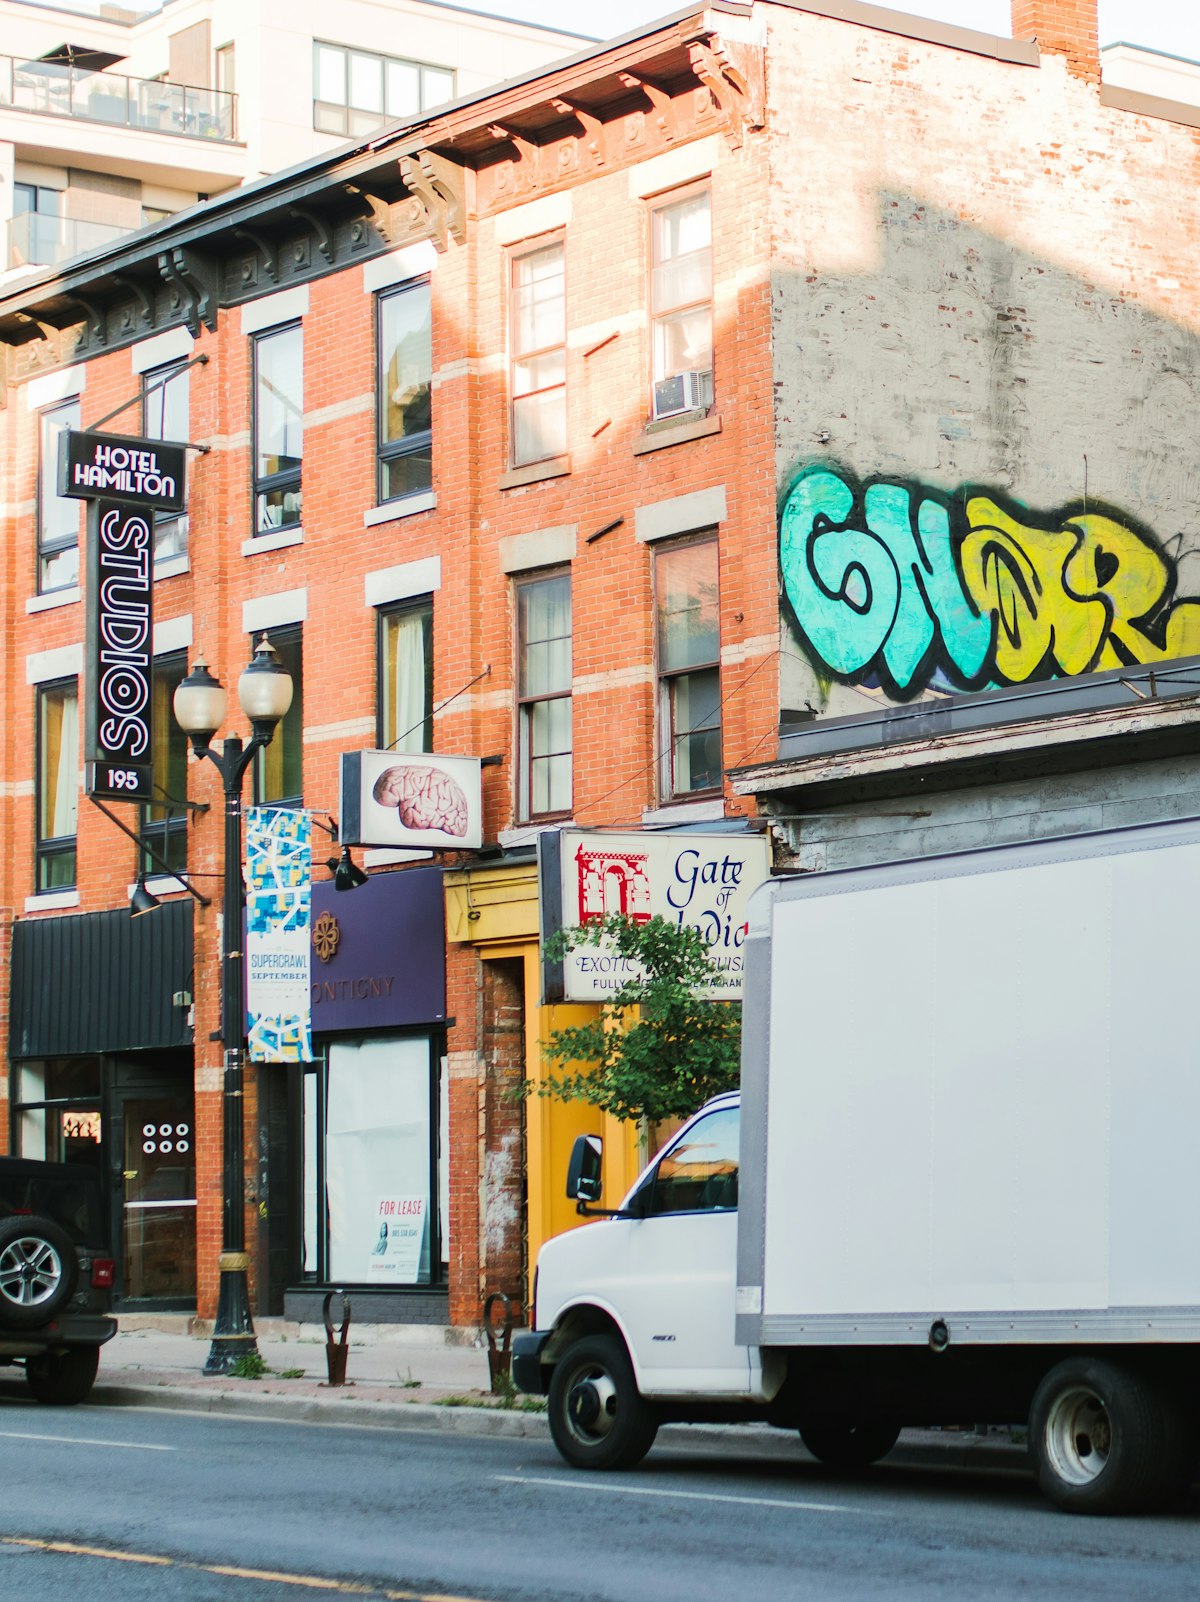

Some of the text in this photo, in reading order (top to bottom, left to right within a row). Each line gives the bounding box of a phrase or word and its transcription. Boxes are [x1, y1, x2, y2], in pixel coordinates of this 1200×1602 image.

[95, 444, 161, 475] HOTEL
[74, 464, 175, 498] HAMILTON
[100, 508, 150, 757] STUDIOS
[108, 769, 139, 791] 195
[667, 850, 747, 908] Gate
[251, 954, 307, 968] SUPERCRAWL
[576, 957, 637, 973] EXOTIC
[593, 979, 625, 989] FULLY
[379, 1200, 422, 1215] FOR LEASE
